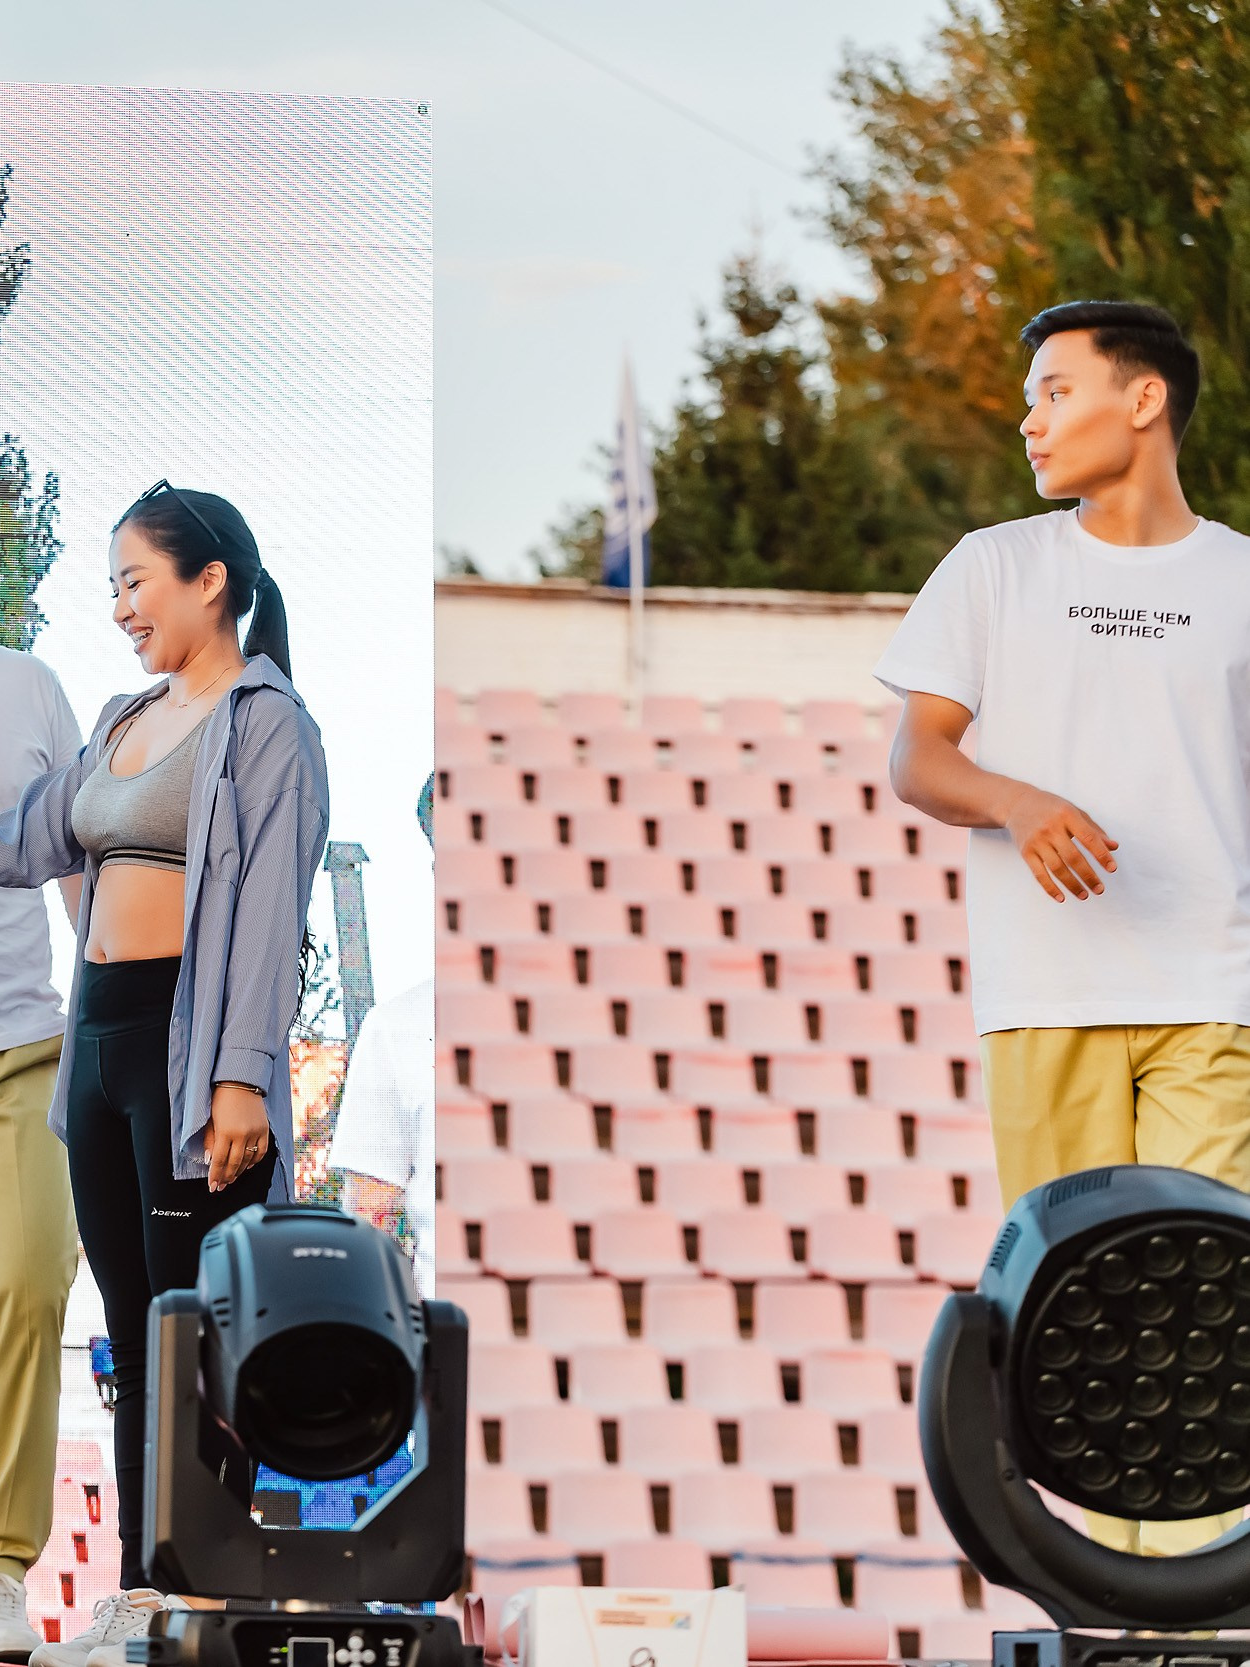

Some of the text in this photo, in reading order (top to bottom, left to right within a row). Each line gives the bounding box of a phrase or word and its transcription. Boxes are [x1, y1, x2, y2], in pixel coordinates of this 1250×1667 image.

[1068, 605, 1191, 626] БОЛЬШЕ ЧЕМ
[1091, 623, 1165, 639] ФИТНЕС
